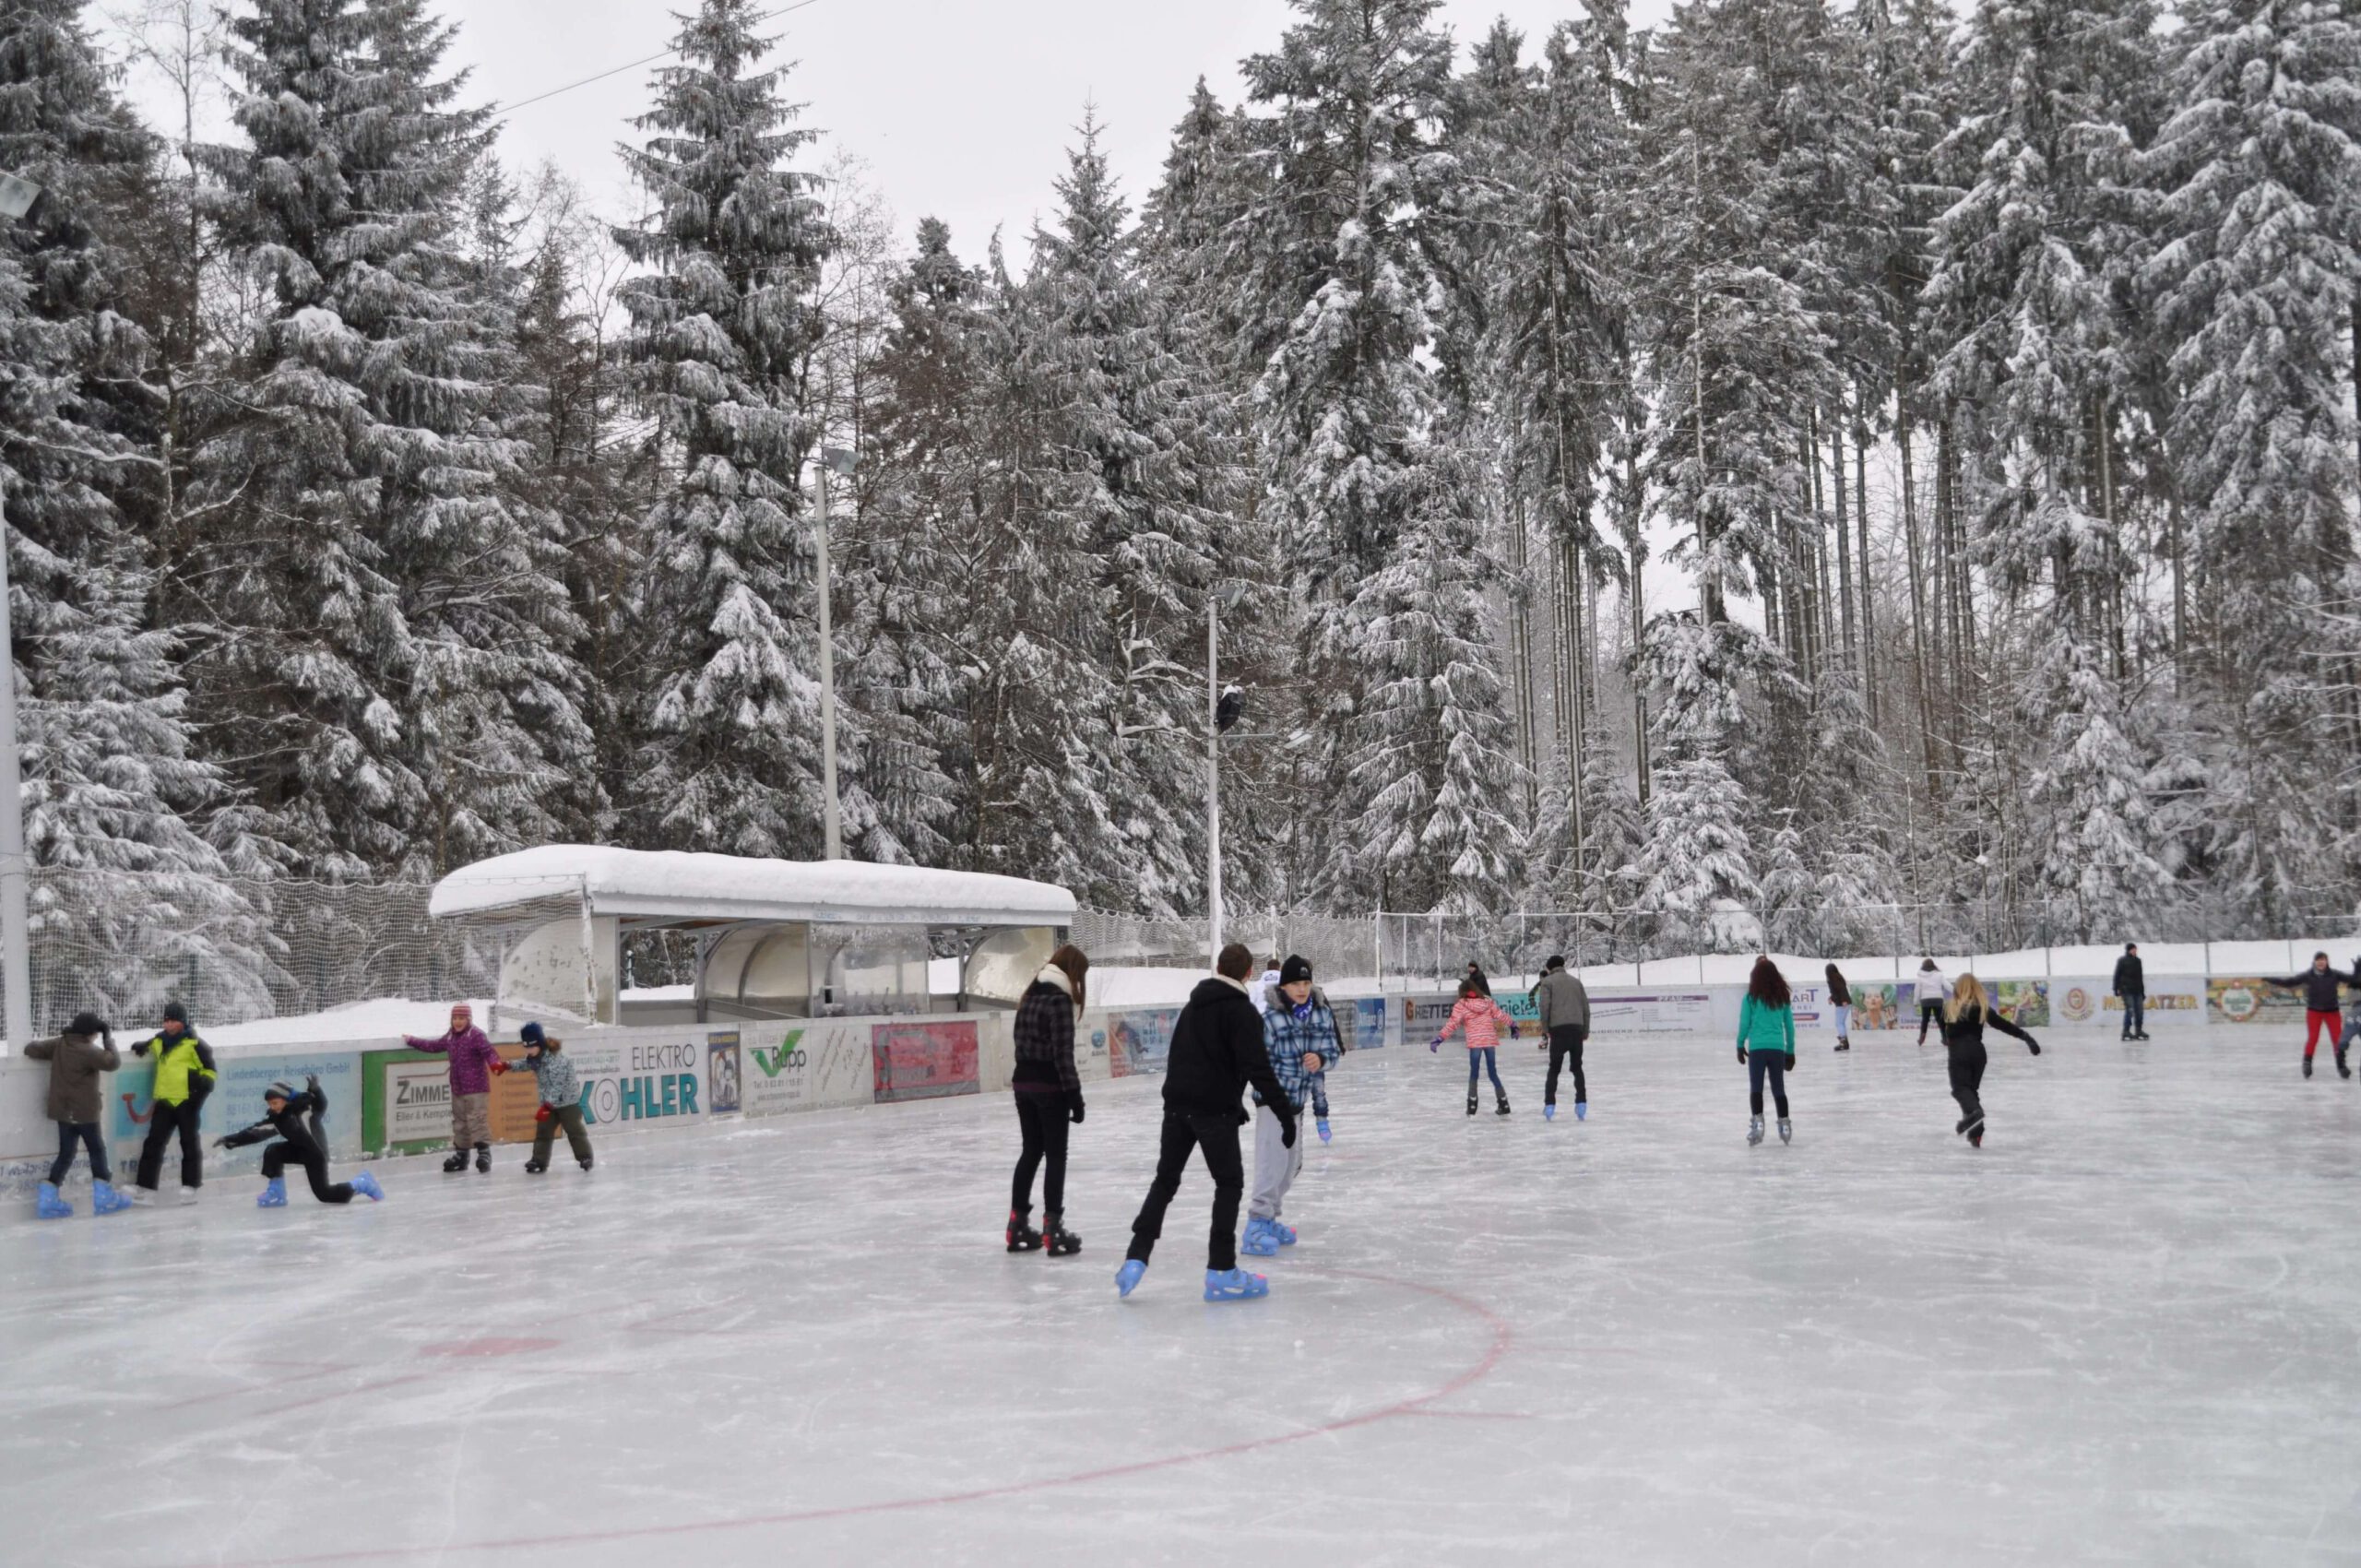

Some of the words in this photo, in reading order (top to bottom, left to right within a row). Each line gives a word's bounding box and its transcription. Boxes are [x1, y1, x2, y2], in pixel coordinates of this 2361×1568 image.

[632, 1043, 696, 1071] ELEKTRO
[772, 1045, 807, 1073] Rupp
[226, 1067, 281, 1081] Lindenberger
[284, 1063, 325, 1076] Reisebüro
[326, 1062, 350, 1074] GmbH
[396, 1080, 451, 1105] ZIMME
